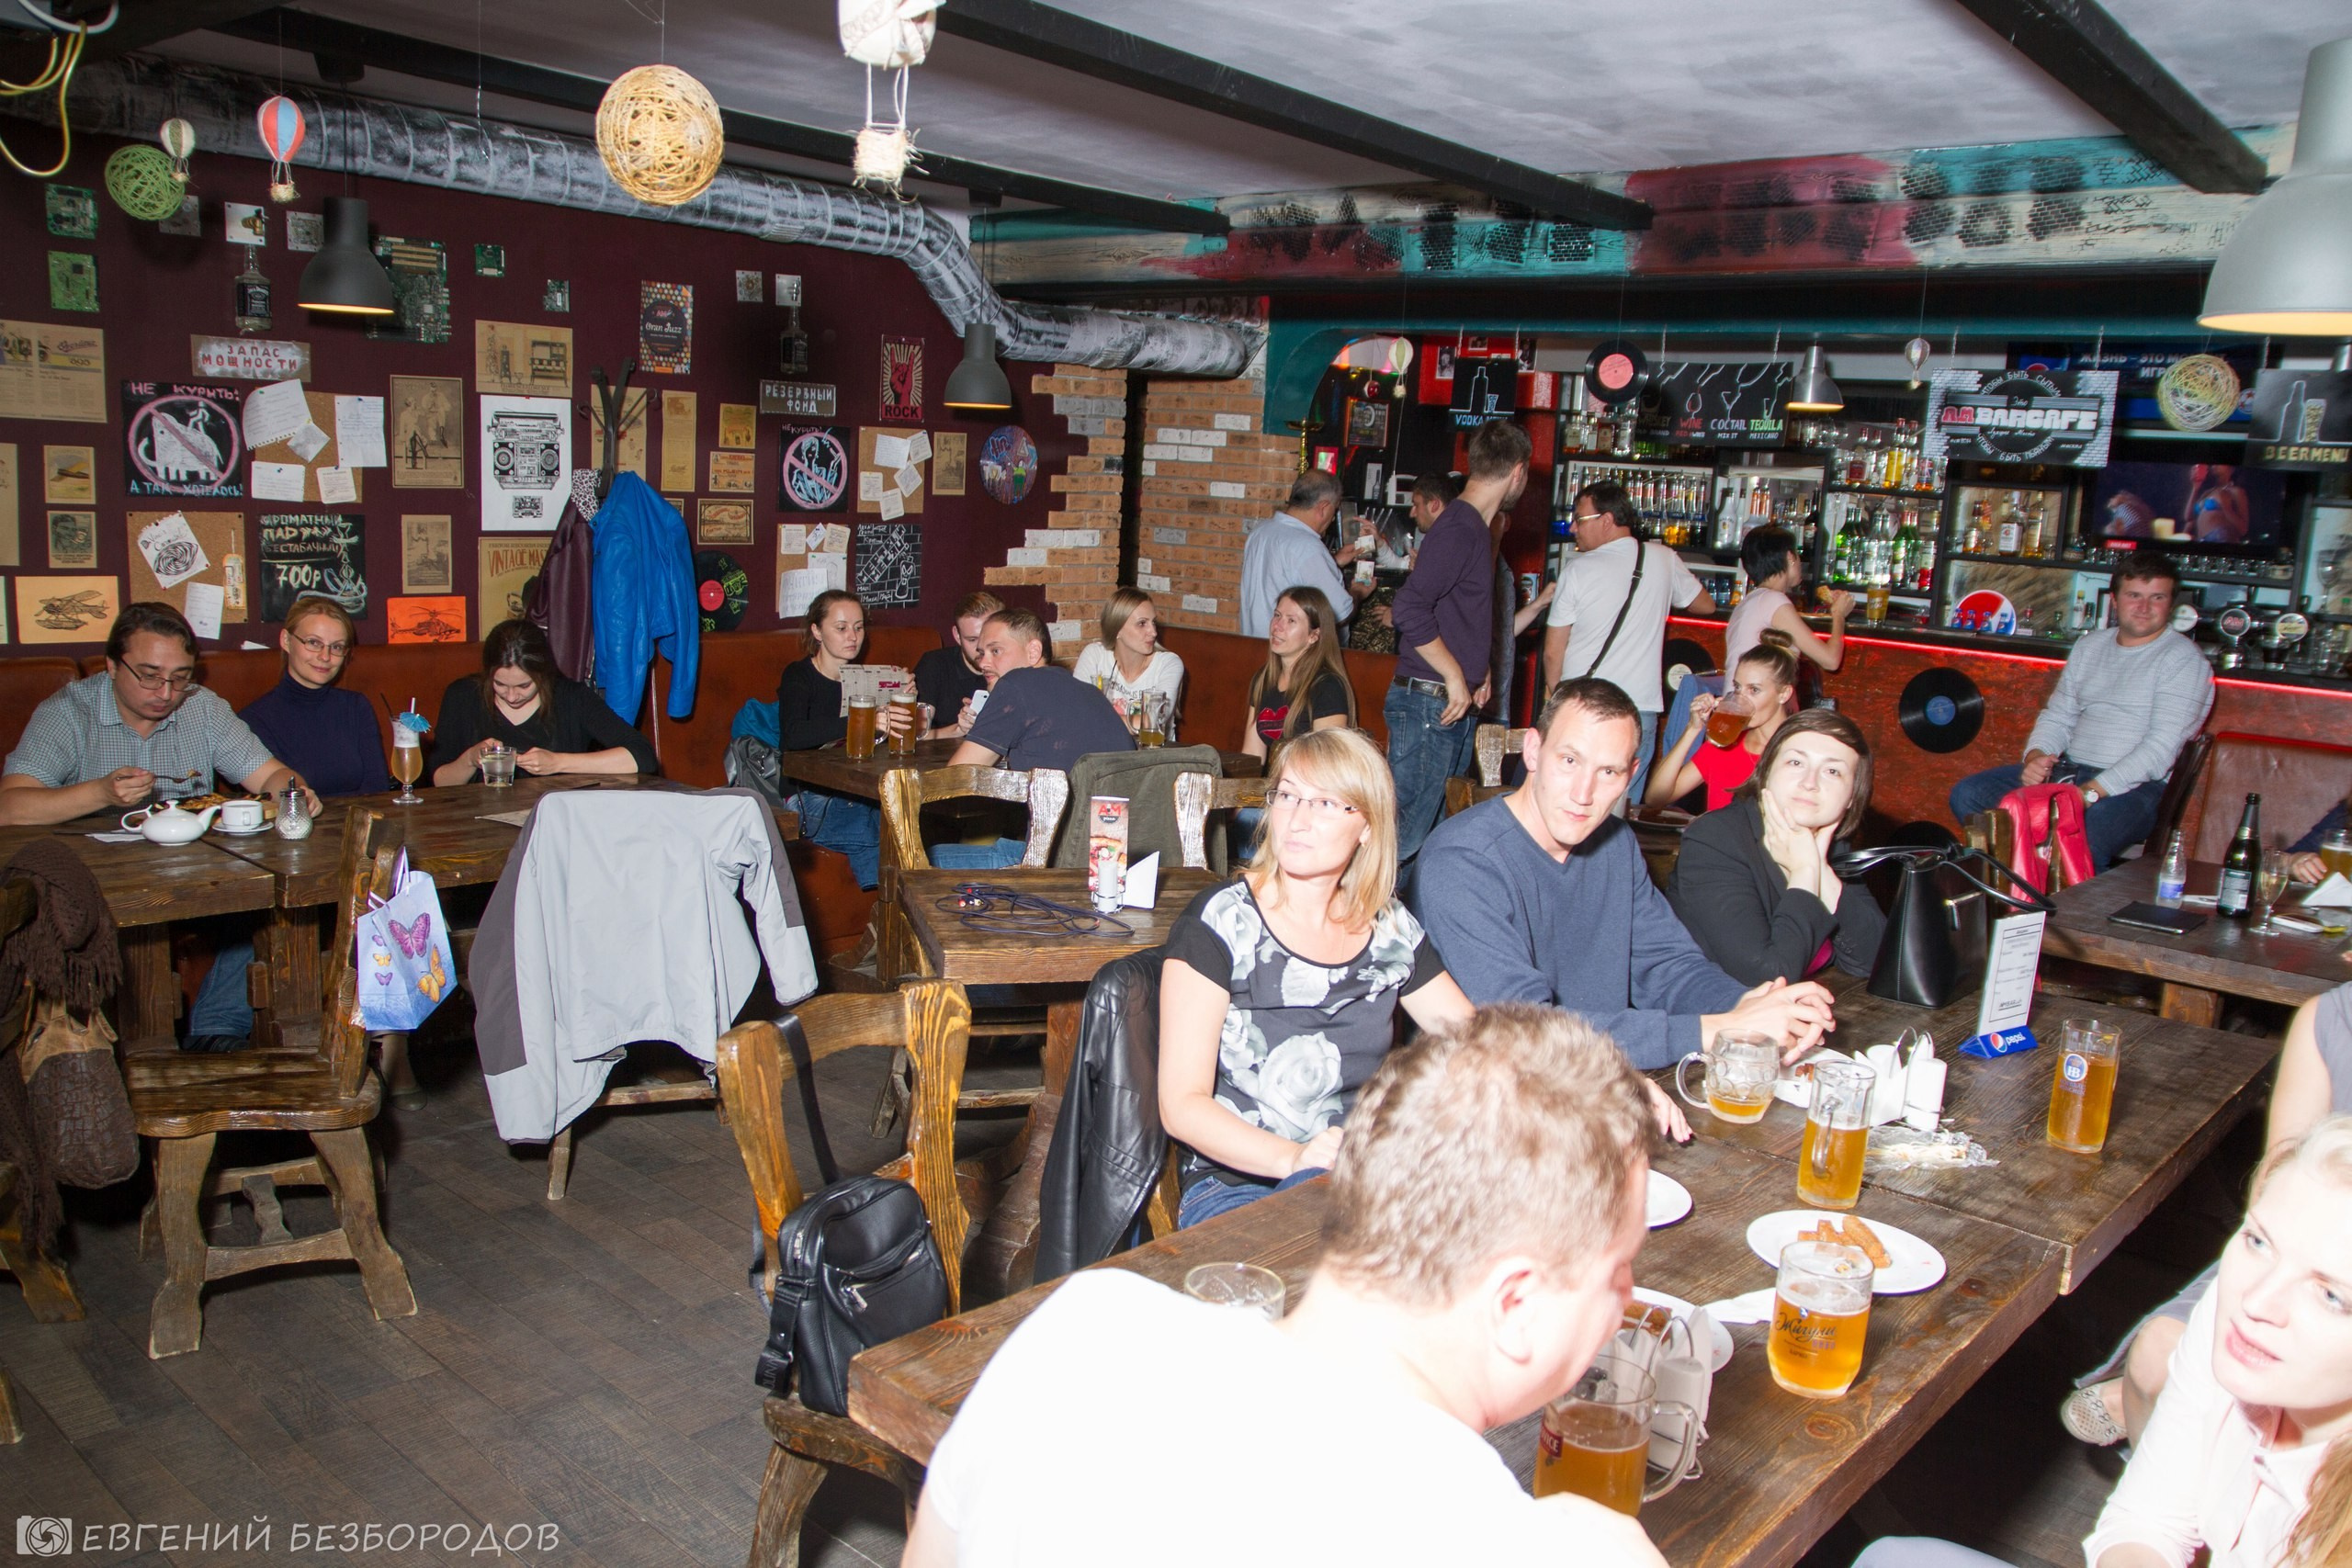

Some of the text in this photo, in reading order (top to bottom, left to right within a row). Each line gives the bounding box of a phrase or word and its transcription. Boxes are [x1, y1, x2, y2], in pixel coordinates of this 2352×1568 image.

[227, 344, 279, 357] ЗАПАС
[202, 353, 297, 369] МОЩНОСТИ
[2139, 354, 2165, 363] ЭТО
[131, 382, 156, 395] НЕ
[1981, 371, 2062, 397] ЧТОБЫ БЫТЬ СЫТЫМ
[786, 399, 818, 413] ФОНД
[885, 405, 919, 418] ROCK
[1454, 414, 1484, 426] VODKA
[1679, 418, 1703, 430] WINE
[1710, 418, 1747, 431] COCTAIL
[1749, 419, 1784, 431] TEQUILA
[1999, 452, 2022, 462] БЫТЬ
[130, 479, 140, 493] А
[142, 481, 173, 495] ТАК
[263, 526, 299, 541] ПАР
[488, 549, 527, 578] VINTAGE
[2006, 1032, 2026, 1045] pepsi
